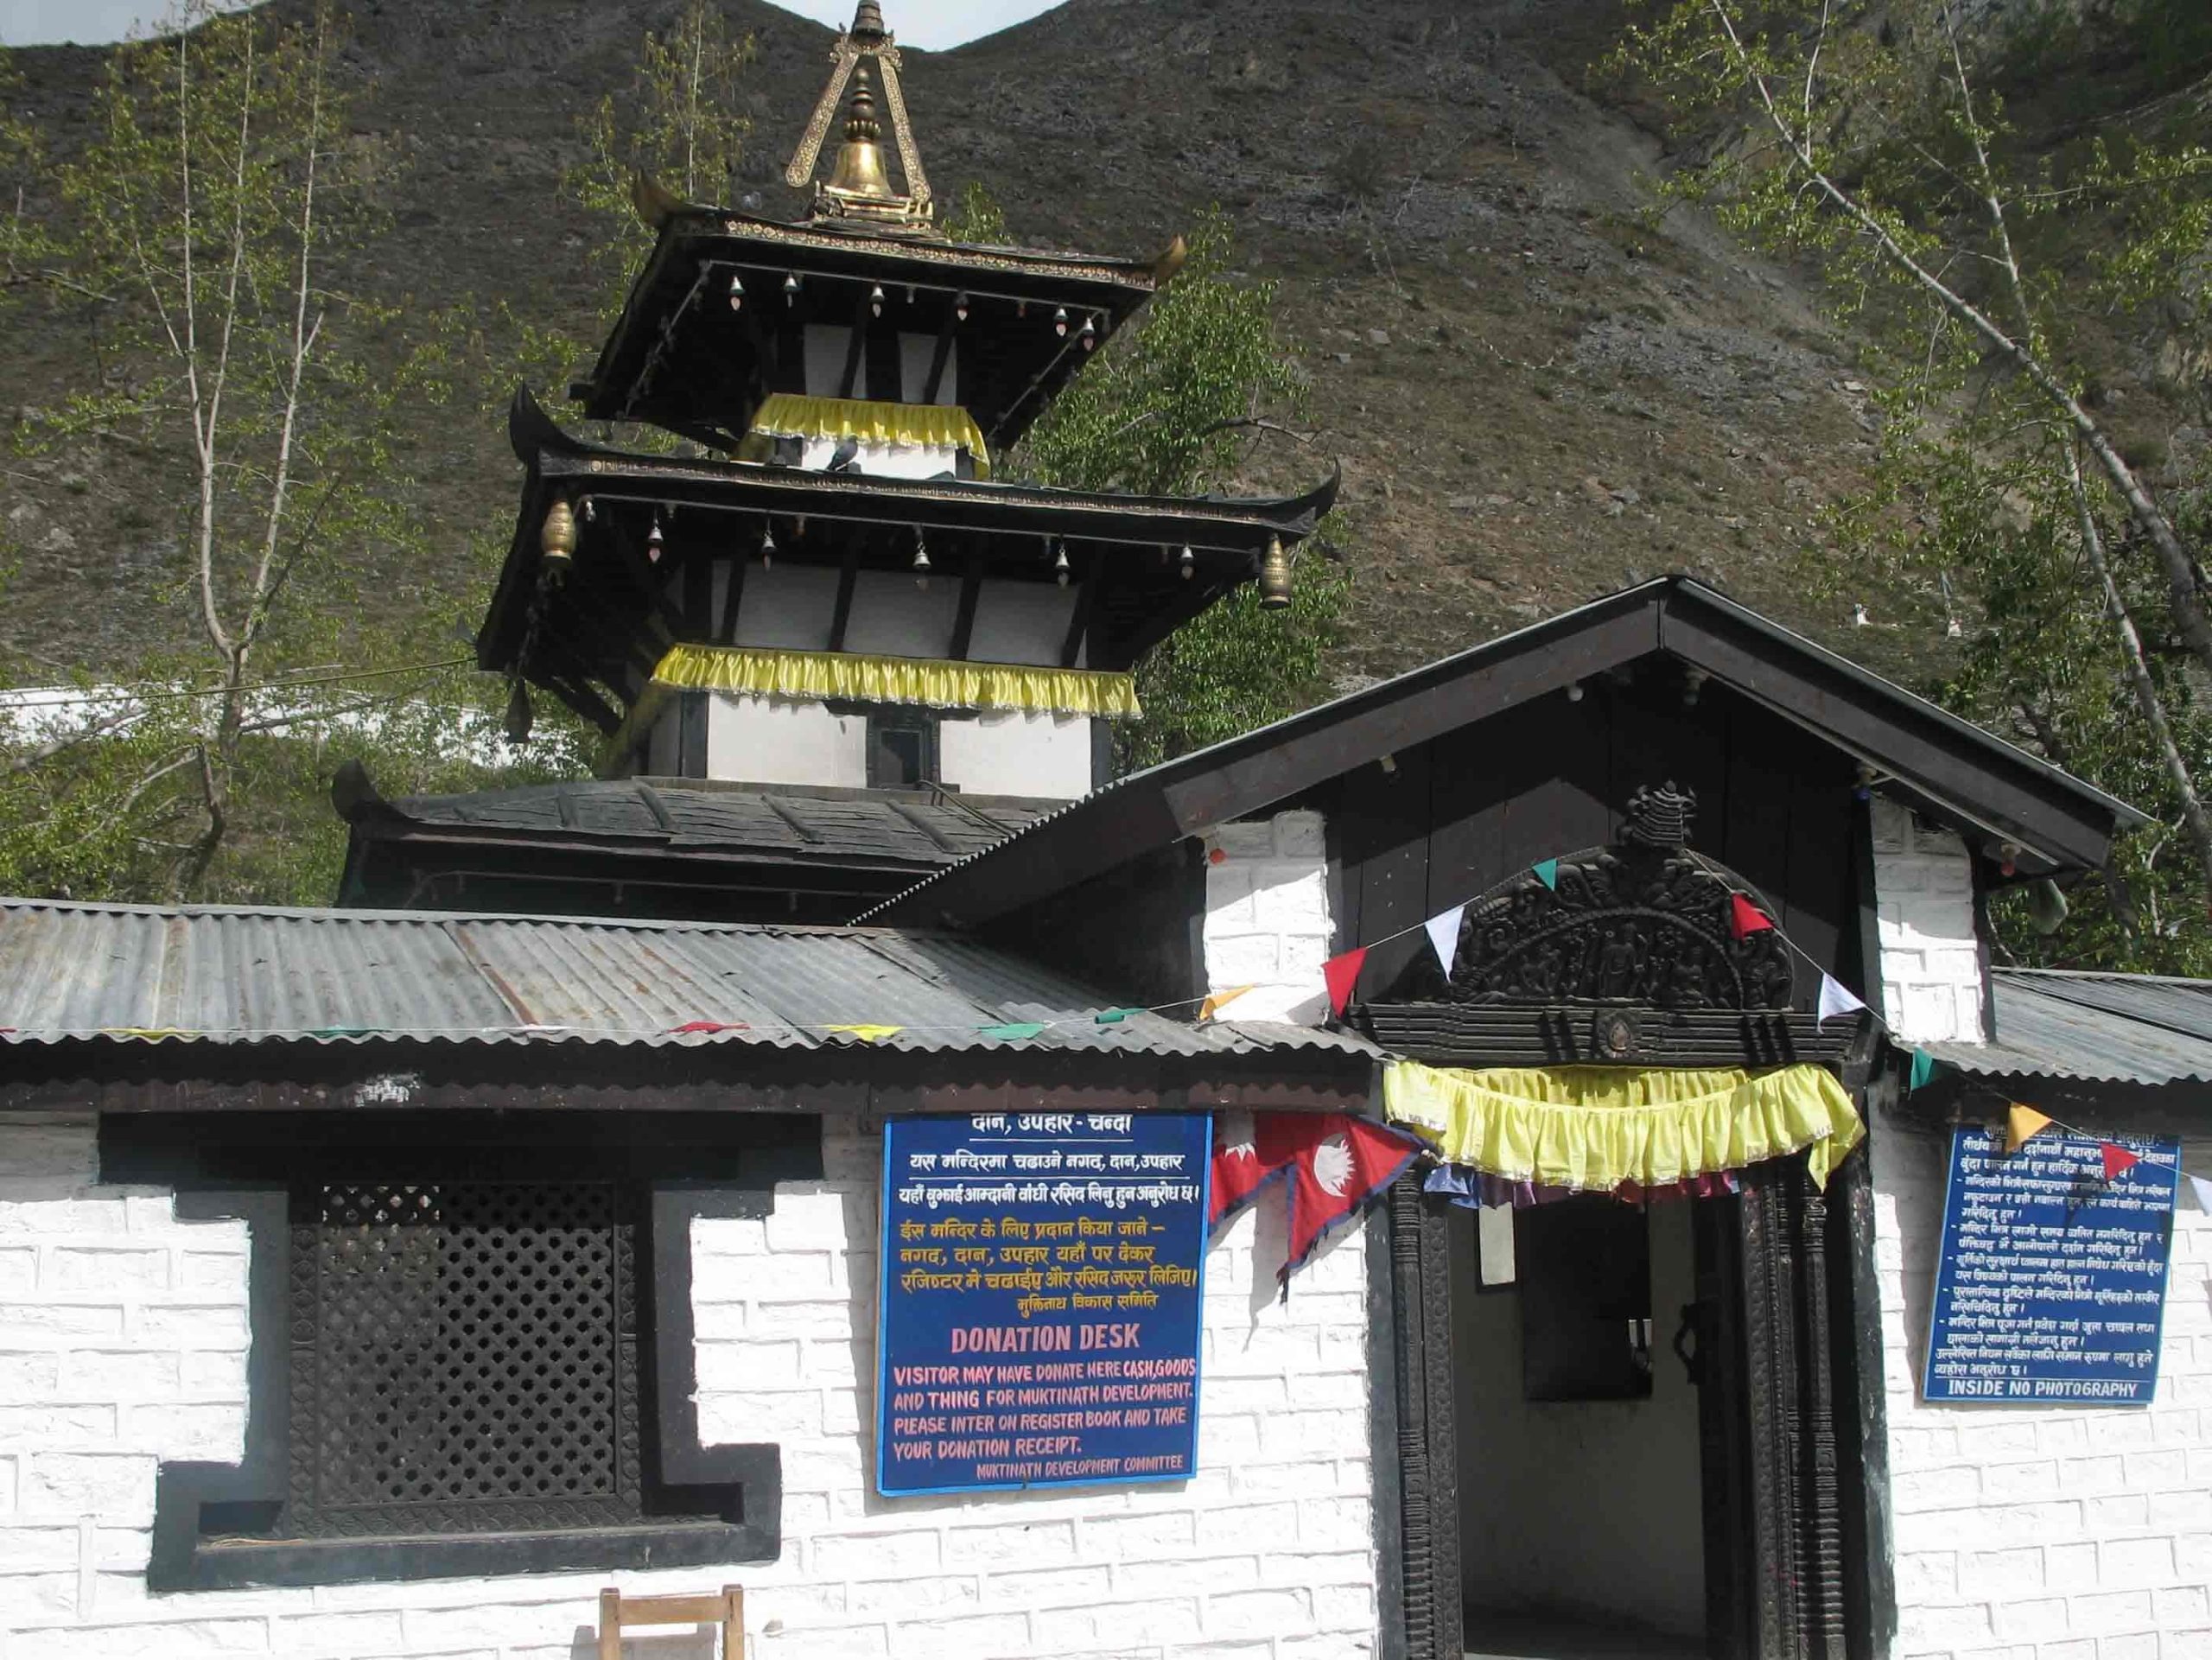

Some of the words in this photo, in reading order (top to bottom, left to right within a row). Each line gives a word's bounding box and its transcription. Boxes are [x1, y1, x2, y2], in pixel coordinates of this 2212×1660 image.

[971, 1113, 1012, 1135] दान,
[1087, 1114, 1133, 1134] चन्दा
[910, 1154, 937, 1172] यस
[941, 1148, 1008, 1172] मन्दिरमा
[1012, 1150, 1063, 1171] चढाउने
[899, 1183, 925, 1205] यहाँ
[963, 1182, 1017, 1205] आम्दानी
[1051, 1181, 1085, 1205] रसिद
[1088, 1181, 1115, 1209] लिनु
[1116, 1185, 1135, 1209] हुन
[1136, 1180, 1179, 1208] अनुरोध
[930, 1217, 977, 1241] मन्दिर
[980, 1218, 996, 1238] के
[1001, 1216, 1031, 1240] लिए
[1034, 1221, 1075, 1240] प्रदान
[1077, 1216, 1114, 1237] किया
[1117, 1216, 1149, 1237] जाने
[999, 1246, 1050, 1266] उपहार
[1057, 1240, 1086, 1262] यहाँ
[1091, 1245, 1115, 1264] पर
[1118, 1241, 1157, 1263] देकर
[1045, 1265, 1073, 1289] और
[1074, 1265, 1110, 1289] रसिद
[1017, 1293, 1068, 1320] मुक्तिनाथ
[1071, 1292, 1114, 1312] विकास
[1117, 1289, 1160, 1311] समिति
[951, 1326, 1071, 1354] DONATION
[1080, 1323, 1141, 1350] DESK
[893, 1365, 960, 1386] VISITOR
[963, 1365, 995, 1383] MAY
[997, 1364, 1033, 1383] HAVE
[1036, 1363, 1084, 1382] DONATE
[1087, 1361, 1122, 1380] HERE
[893, 1391, 925, 1411] AND
[927, 1390, 980, 1409] THING
[986, 1389, 1014, 1407] FOR
[1018, 1386, 1100, 1407] MUKTINATH
[1948, 1379, 2004, 1396] INSIDE
[2008, 1380, 2031, 1396] NO
[2034, 1381, 2139, 1397] PHOTOGRAPHY
[893, 1415, 946, 1435] PLEASE
[951, 1414, 995, 1434] INTER
[998, 1413, 1018, 1432] ON
[1020, 1410, 1084, 1430] REGISTER
[1085, 1409, 1122, 1428] BOOK
[1123, 1408, 1150, 1426] AND
[1153, 1406, 1187, 1424] TAKE
[893, 1441, 932, 1460] YOUR
[938, 1439, 1010, 1459] DONATION
[976, 1461, 1042, 1479] MUKTINATH
[1045, 1458, 1121, 1477] DEVELOPMENT
[1123, 1455, 1184, 1472] COMMITTEE
